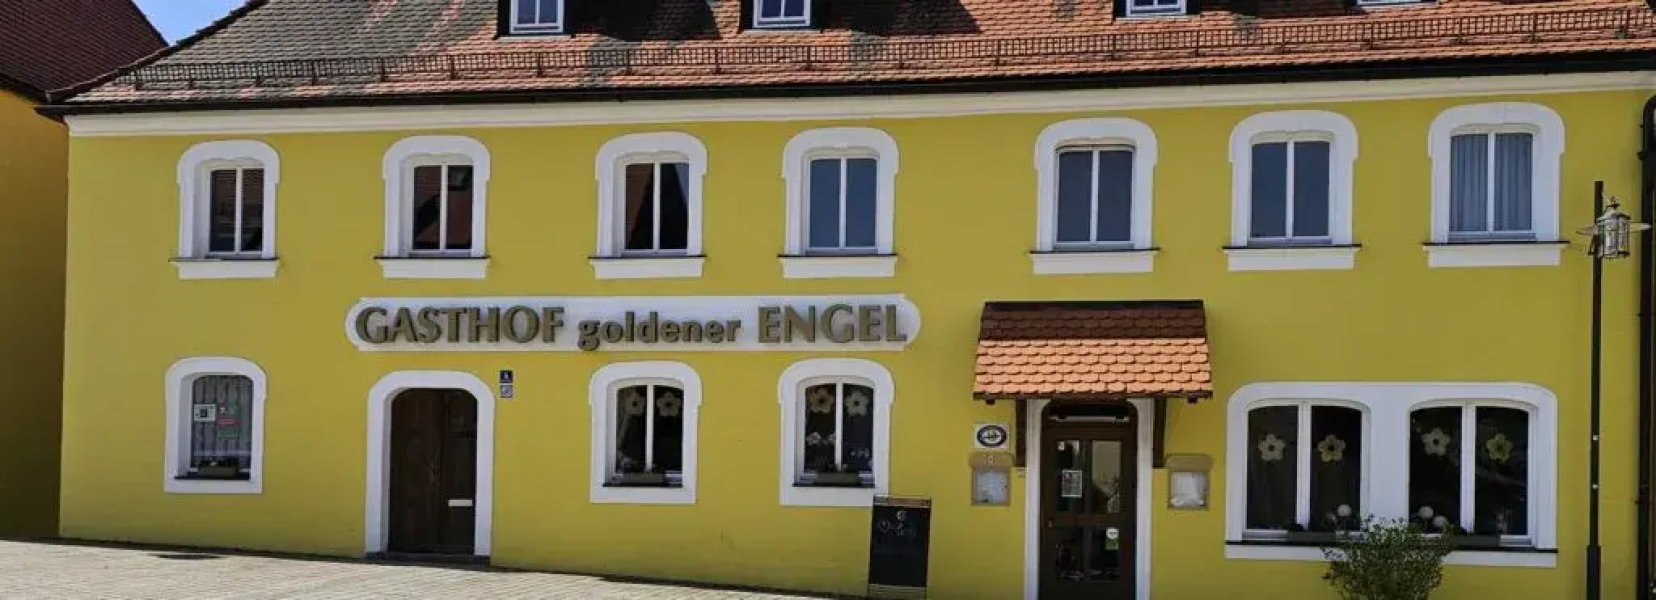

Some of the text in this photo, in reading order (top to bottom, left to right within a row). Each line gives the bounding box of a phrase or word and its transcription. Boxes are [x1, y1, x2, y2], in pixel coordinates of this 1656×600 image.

[355, 304, 907, 351] GASTHOF goldener ENGEL
